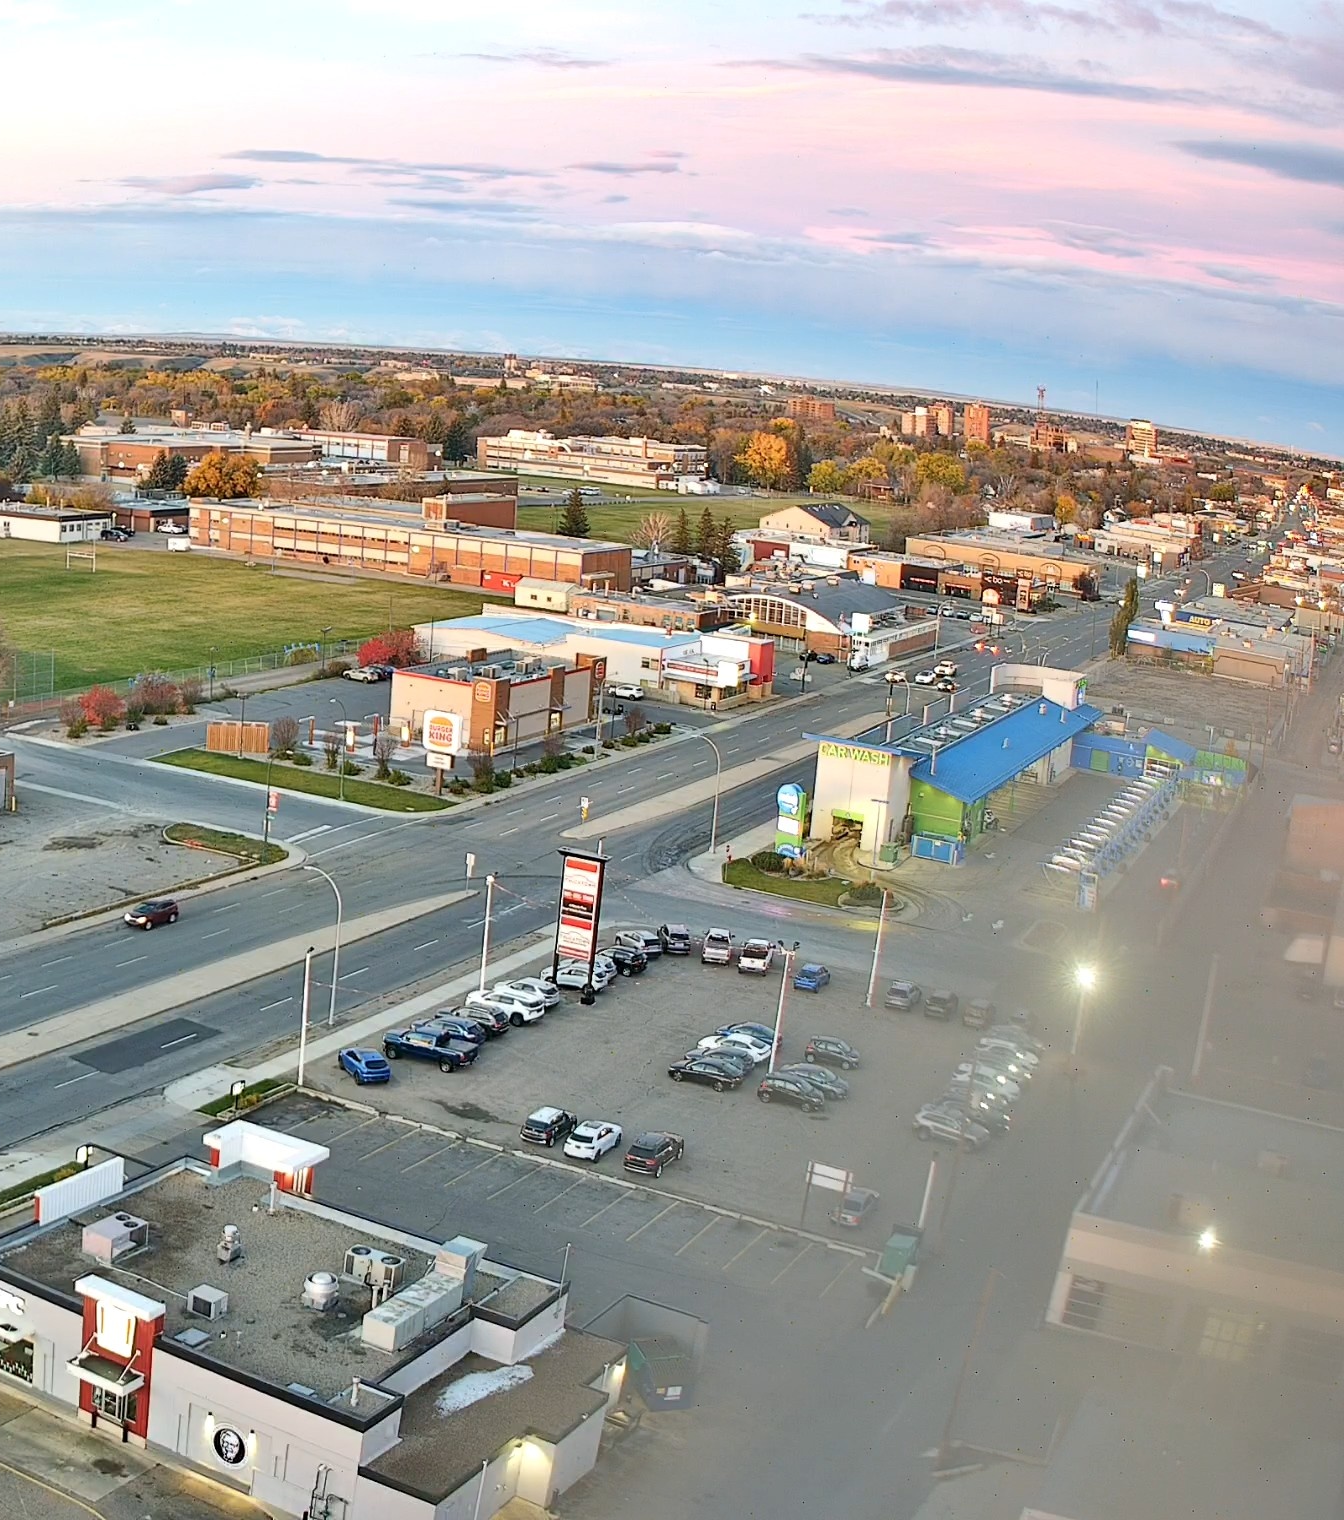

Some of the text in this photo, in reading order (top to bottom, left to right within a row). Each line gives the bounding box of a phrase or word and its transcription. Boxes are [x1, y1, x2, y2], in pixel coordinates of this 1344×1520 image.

[1189, 615, 1211, 626] AUTO
[429, 724, 453, 733] BURGER
[429, 730, 453, 743] KING
[818, 741, 890, 767] CAR WASH
